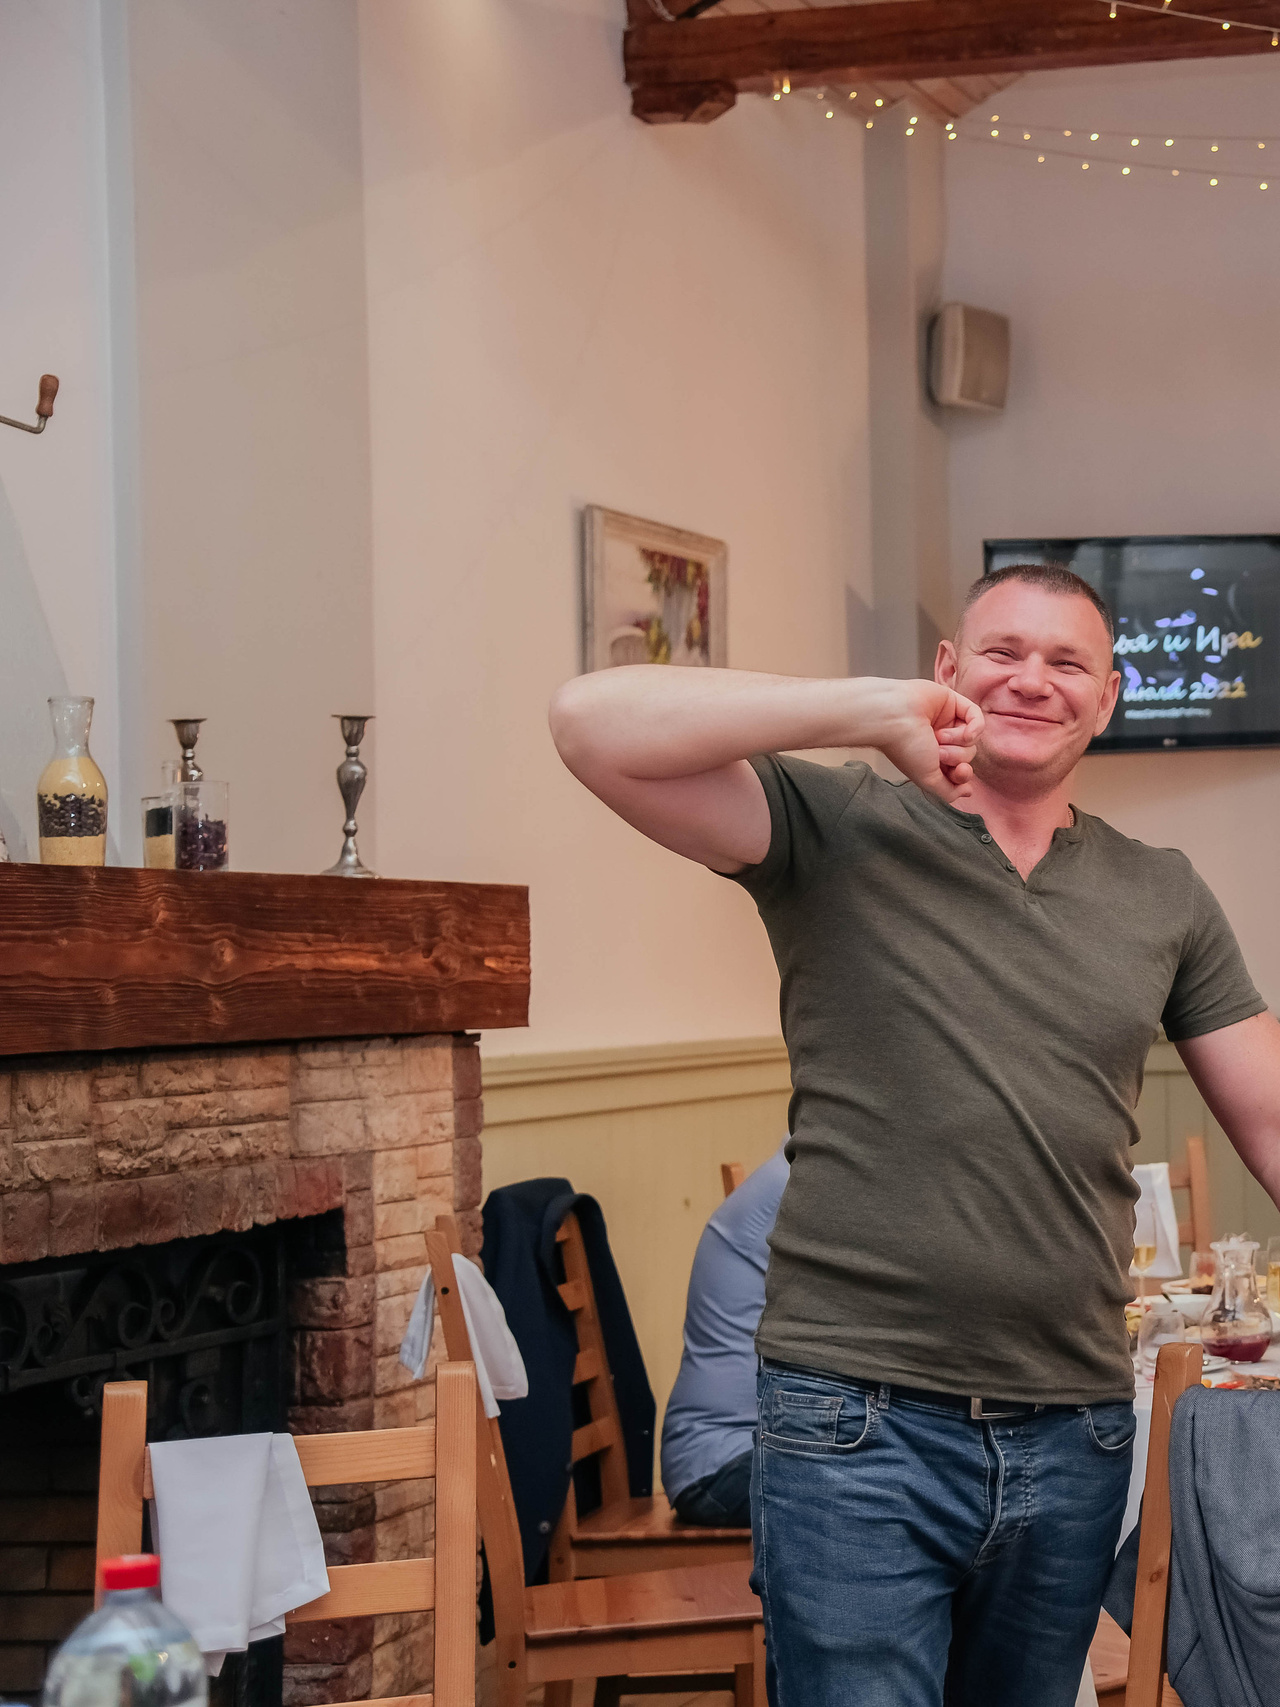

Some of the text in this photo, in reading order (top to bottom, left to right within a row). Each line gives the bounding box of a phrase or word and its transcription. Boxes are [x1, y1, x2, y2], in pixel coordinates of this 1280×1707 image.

[1163, 634, 1191, 653] и
[1196, 625, 1263, 657] Ира
[1189, 681, 1247, 701] 2022
